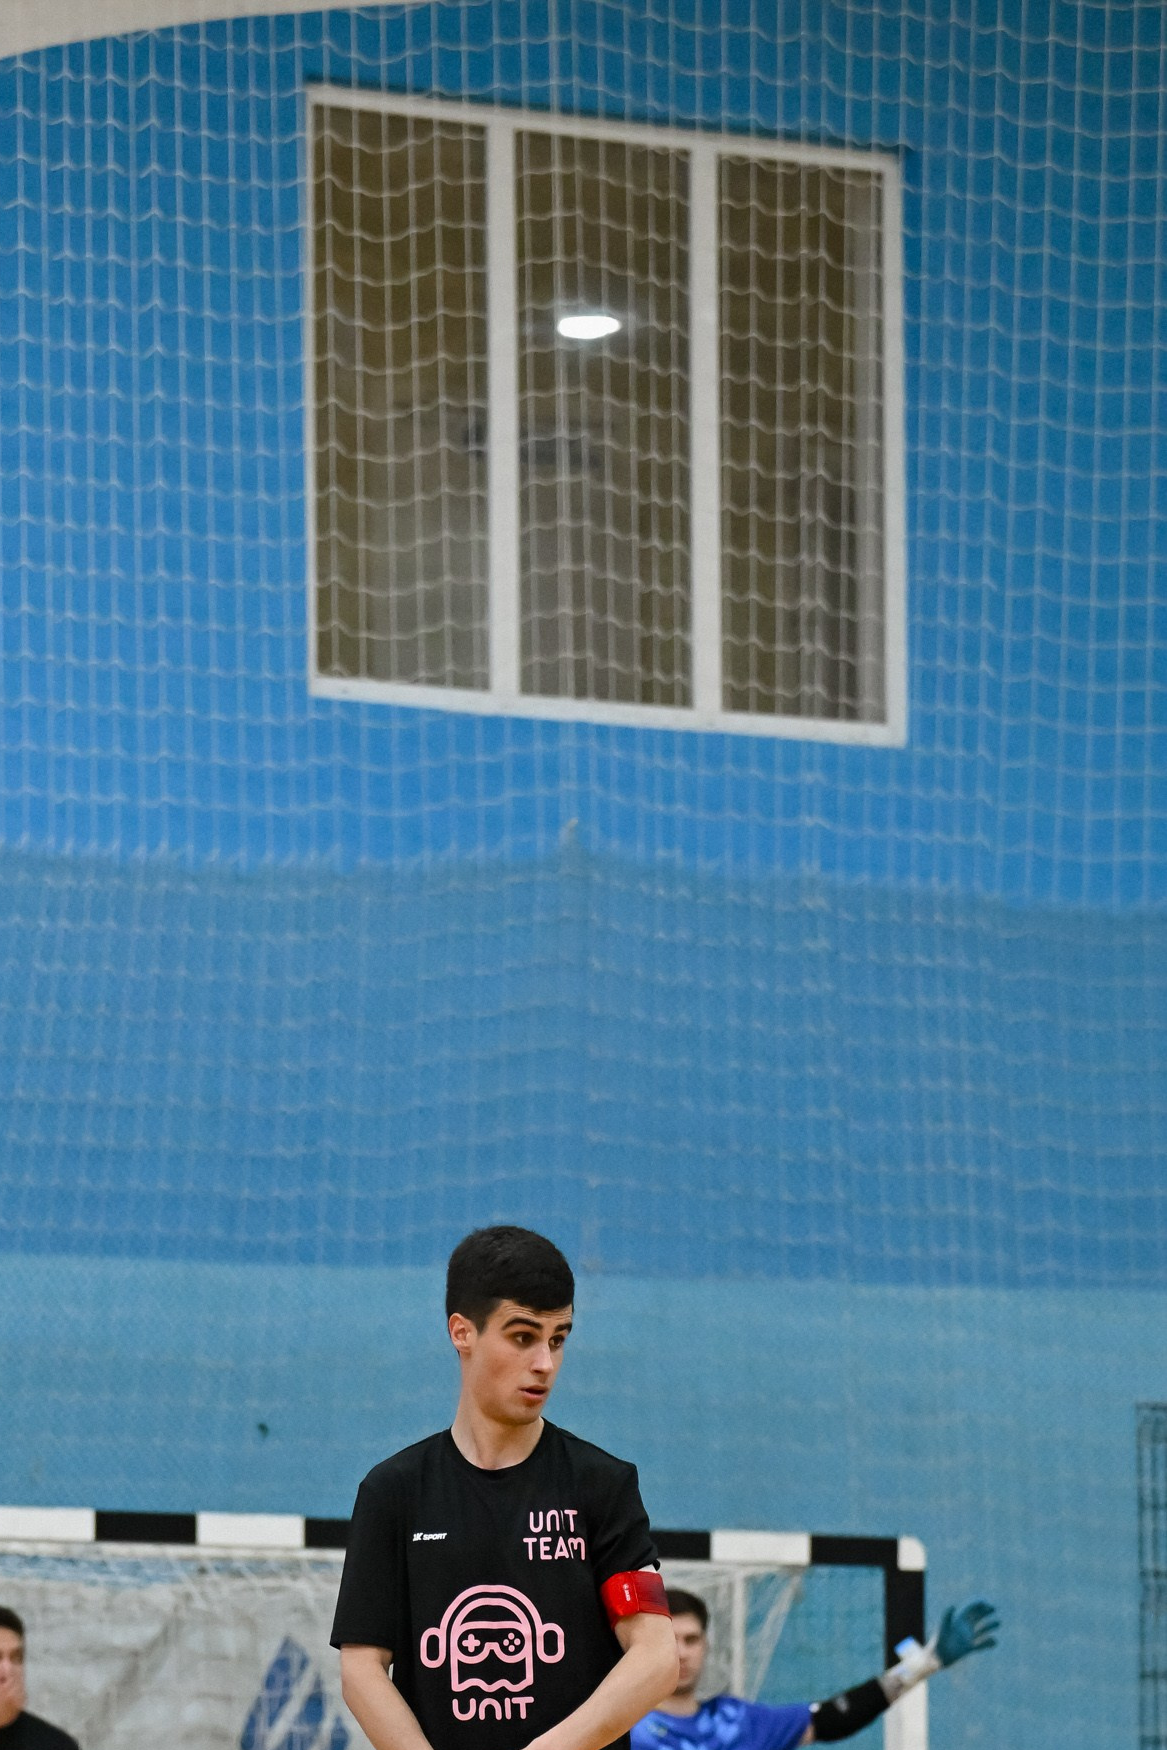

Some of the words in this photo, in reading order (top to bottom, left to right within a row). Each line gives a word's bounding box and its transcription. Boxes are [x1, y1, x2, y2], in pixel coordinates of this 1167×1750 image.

[423, 1532, 448, 1541] SPORT
[522, 1536, 586, 1561] TEAM
[452, 1696, 535, 1721] UNIT
